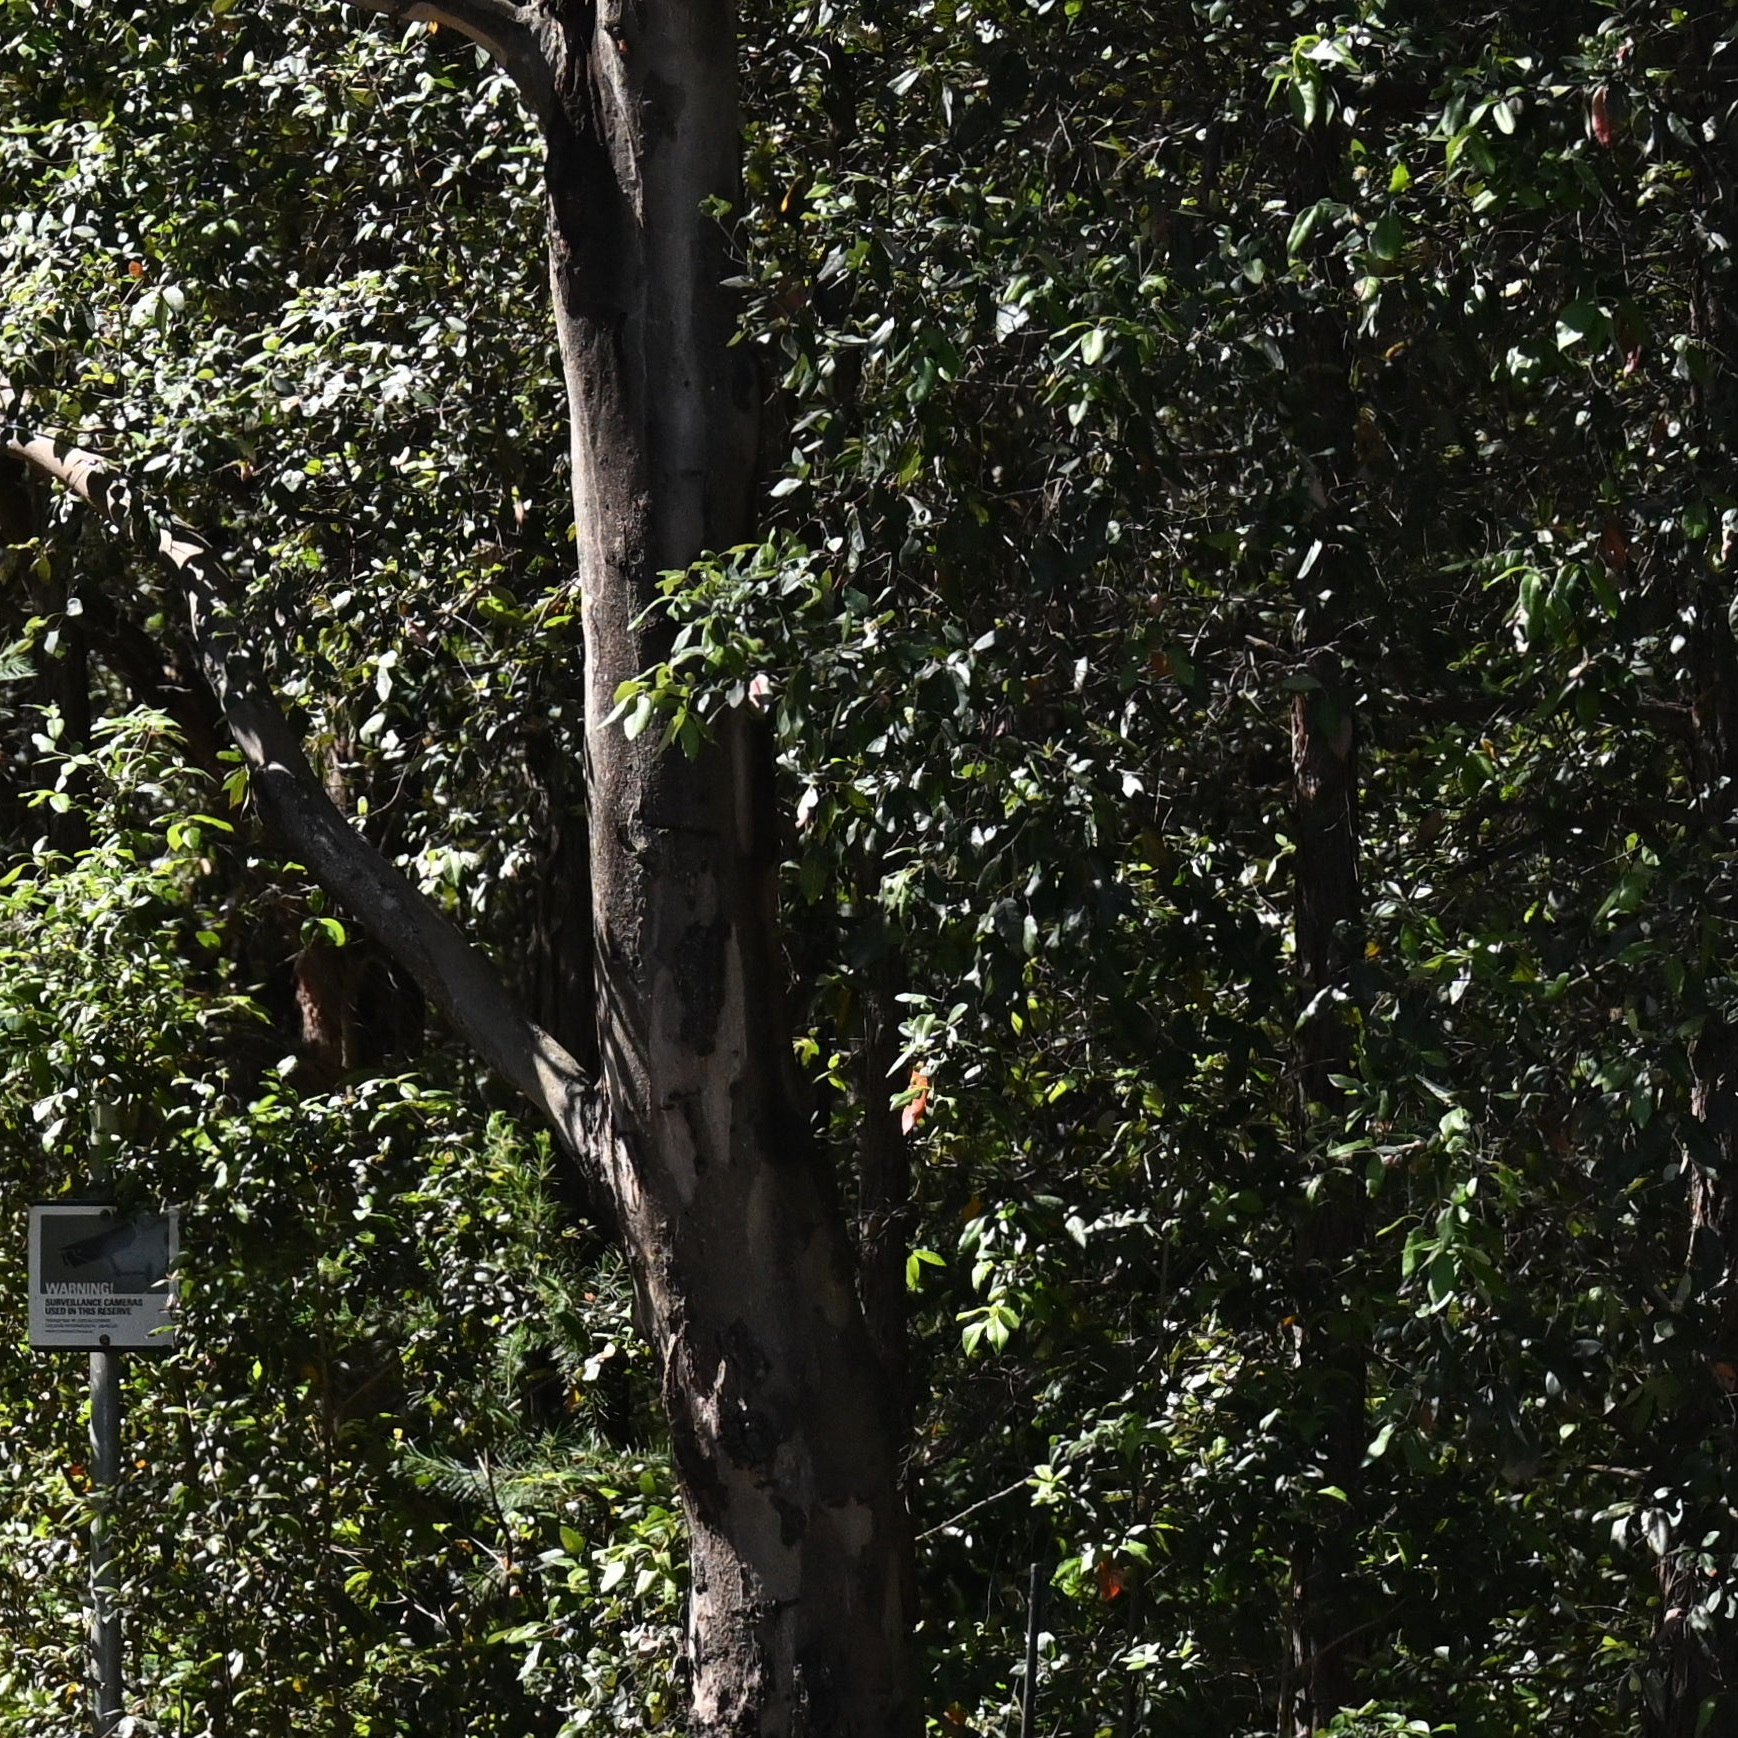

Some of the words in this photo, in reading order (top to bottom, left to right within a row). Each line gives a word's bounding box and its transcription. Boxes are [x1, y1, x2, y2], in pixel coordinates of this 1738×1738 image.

[45, 1282, 114, 1295] WARNING!
[45, 1298, 102, 1307] SURVEILLANCE
[103, 1298, 143, 1307] CAMERAS
[45, 1307, 67, 1316] USED
[68, 1307, 77, 1316] IN
[79, 1307, 96, 1316] THIS
[97, 1307, 132, 1316] RESERVE
